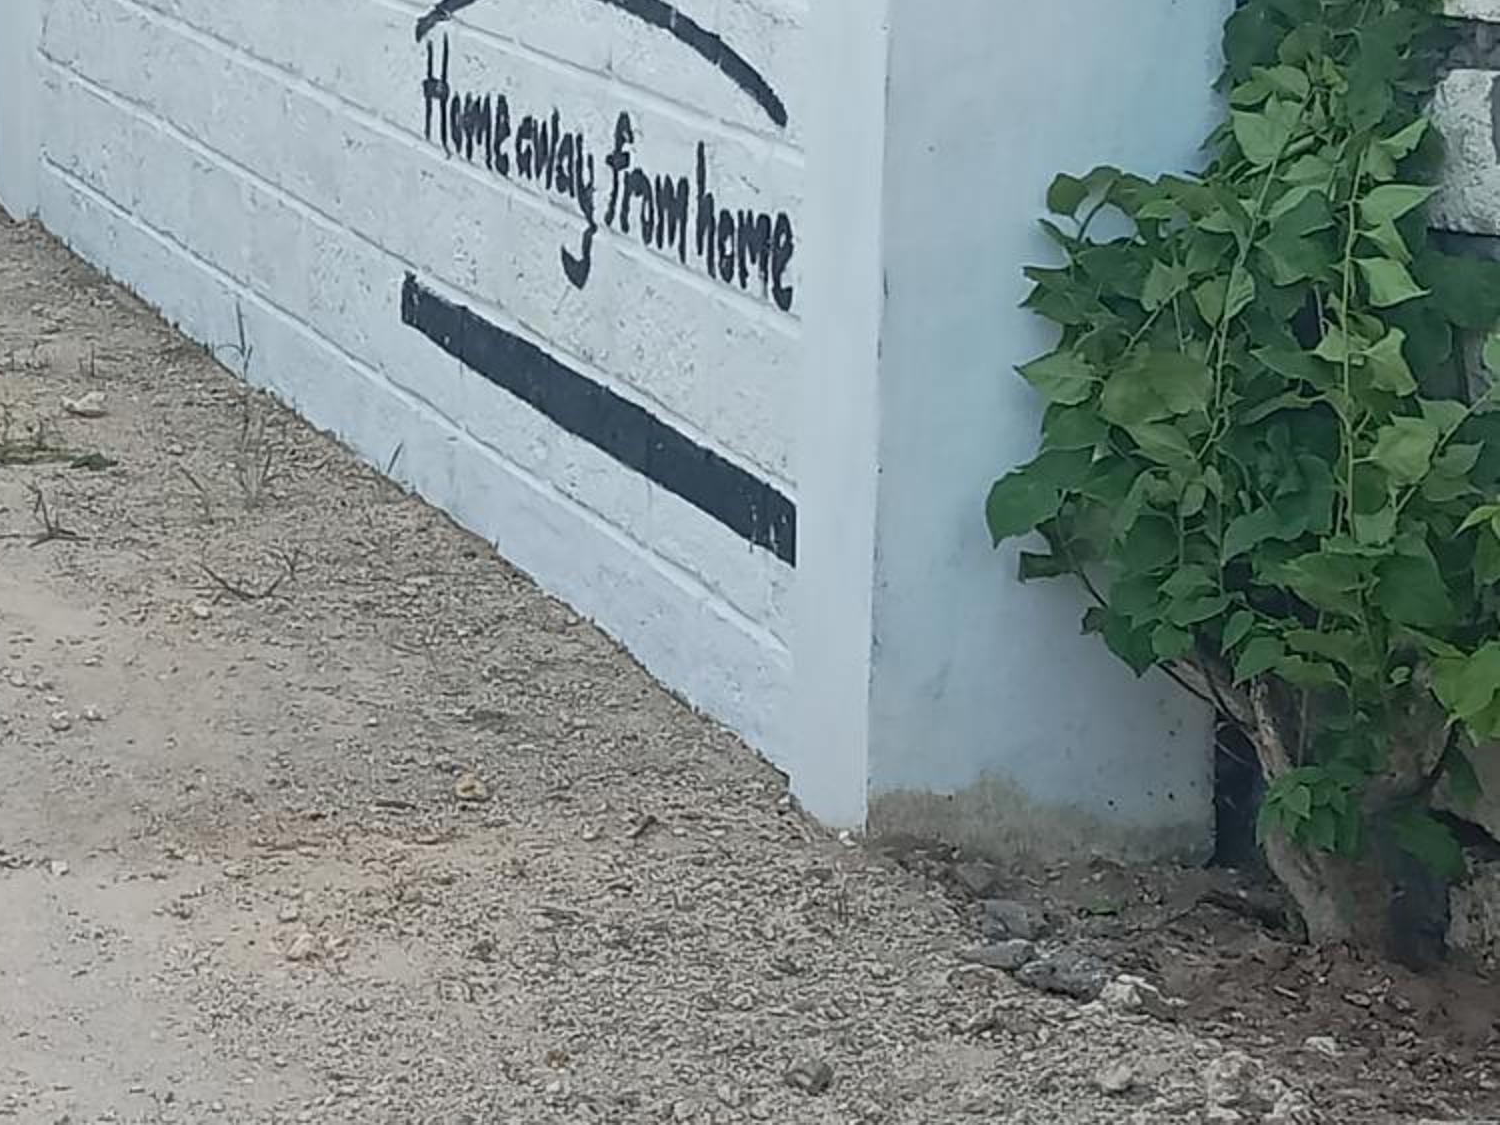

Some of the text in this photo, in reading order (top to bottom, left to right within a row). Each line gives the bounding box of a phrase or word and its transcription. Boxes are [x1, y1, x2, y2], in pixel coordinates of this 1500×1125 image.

[423, 31, 793, 311] Home away from home
